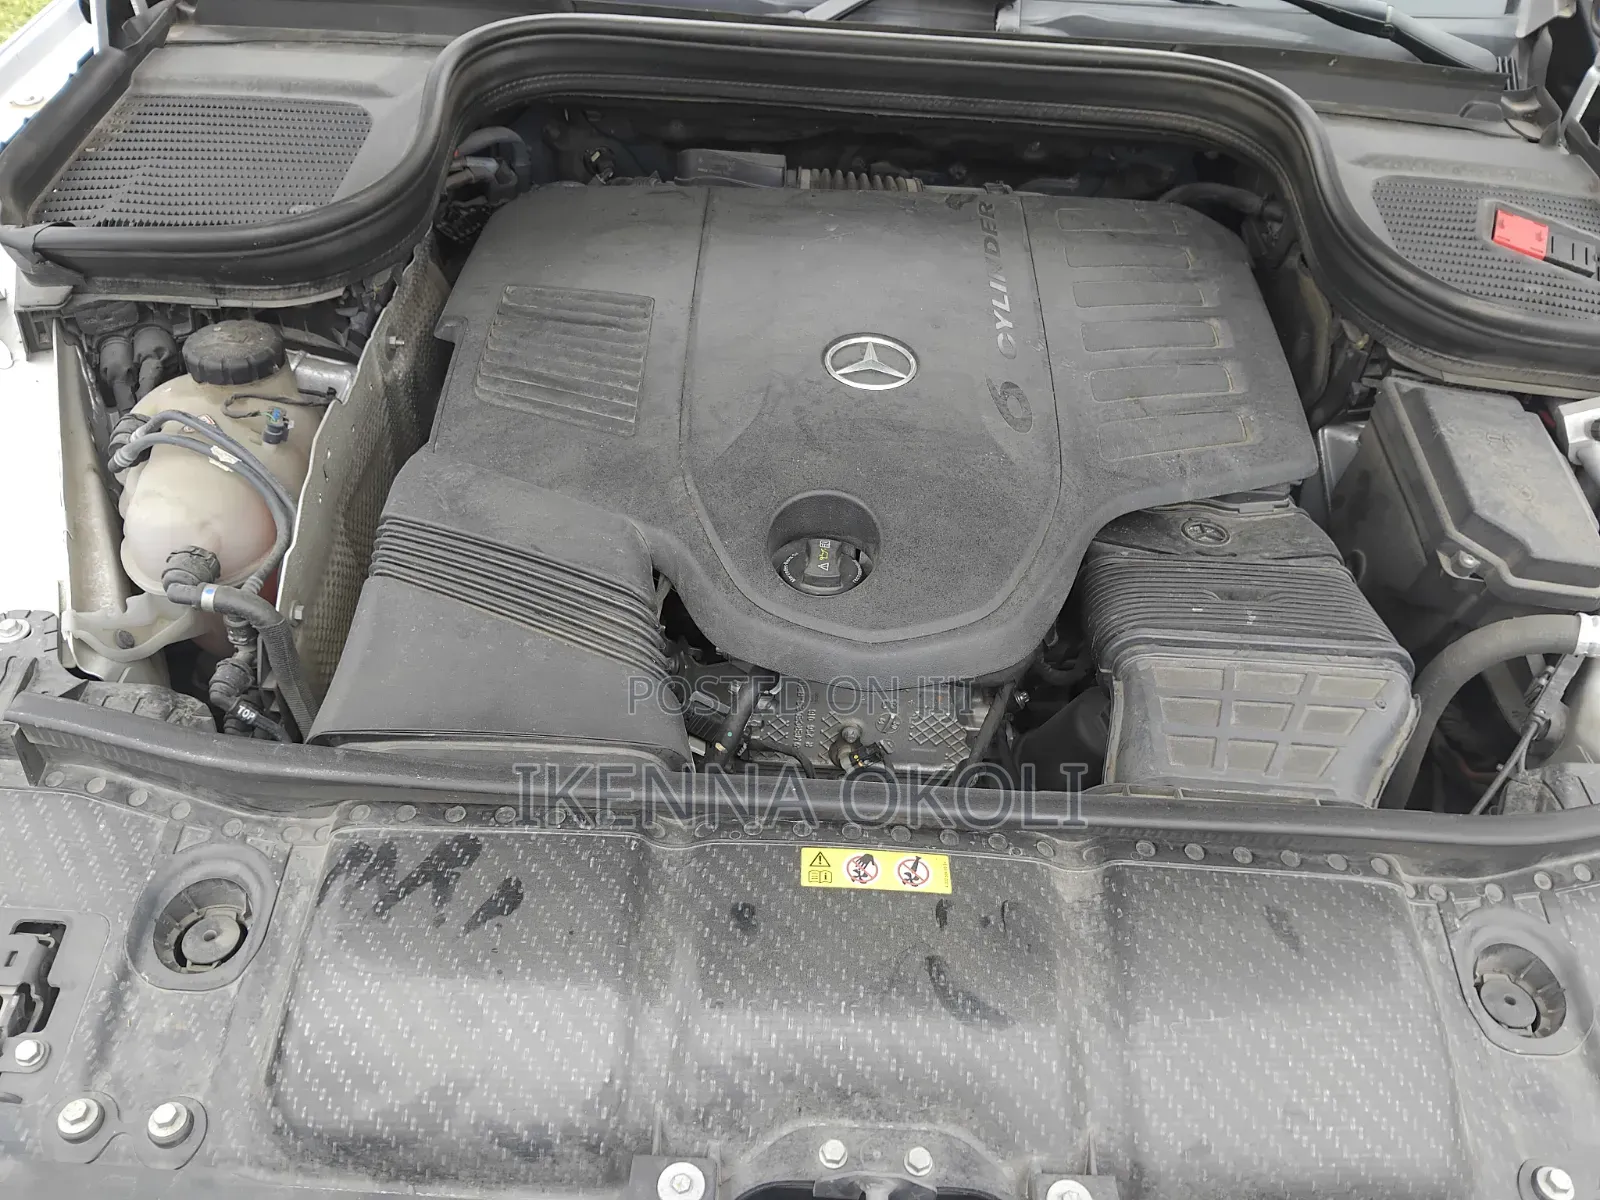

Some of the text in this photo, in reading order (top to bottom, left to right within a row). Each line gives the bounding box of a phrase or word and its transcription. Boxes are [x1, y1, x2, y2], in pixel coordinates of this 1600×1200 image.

[978, 201, 1032, 433] 6 CYLINDER
[237, 705, 256, 720] TOP
